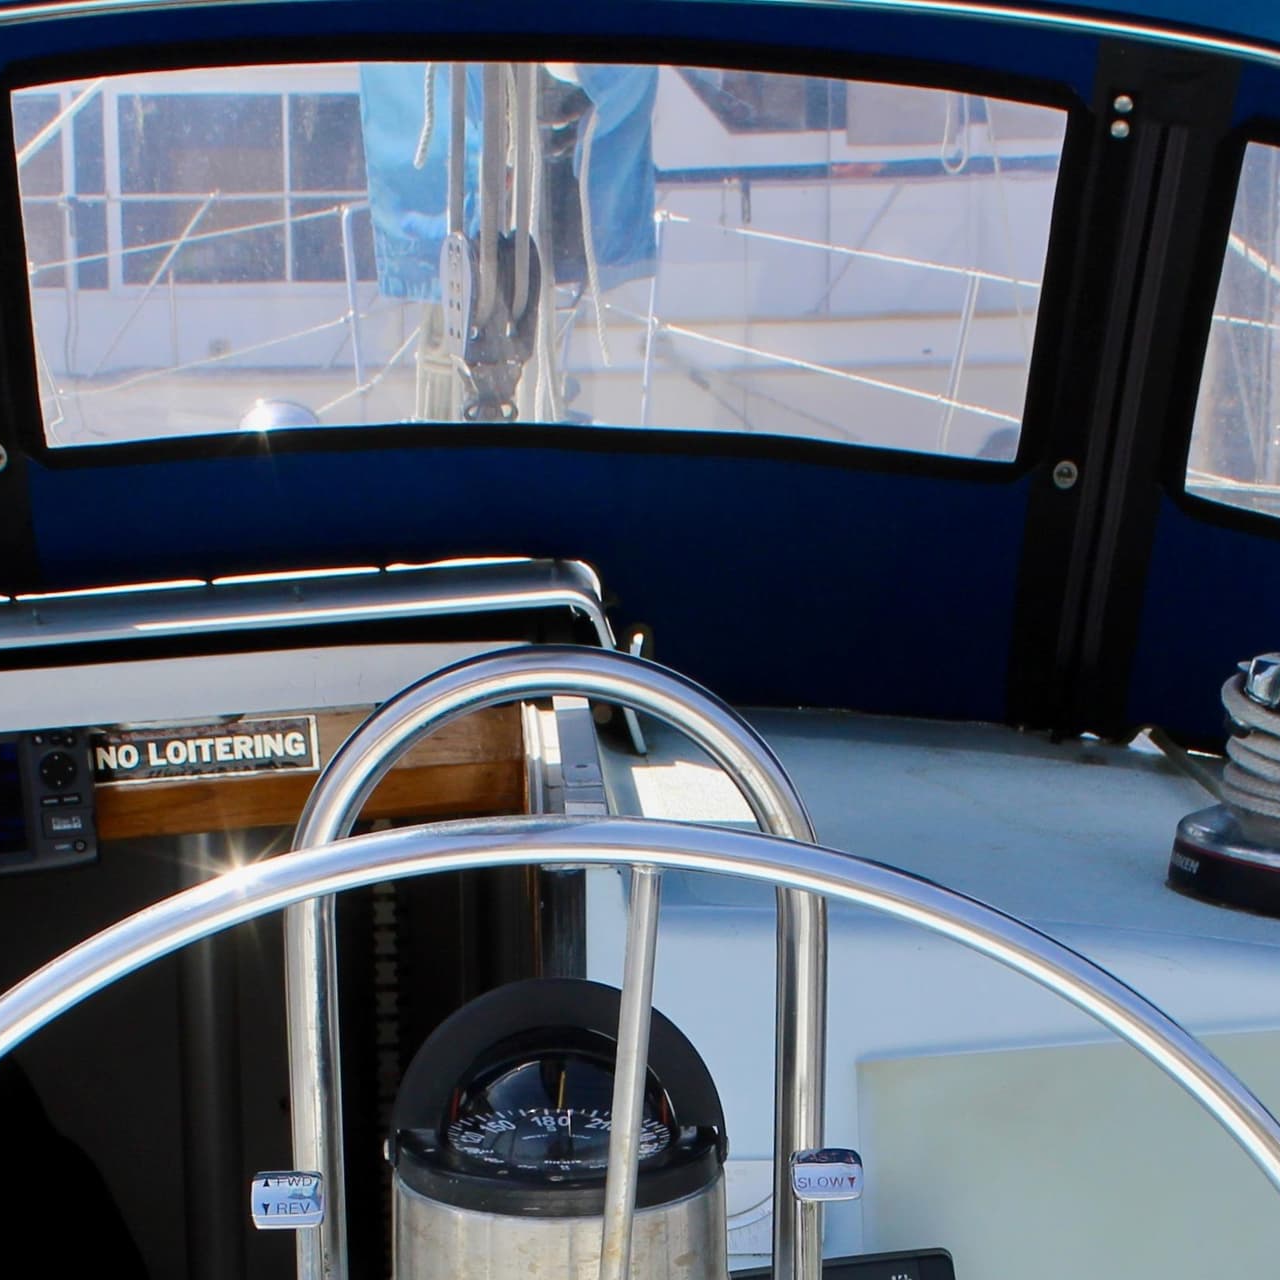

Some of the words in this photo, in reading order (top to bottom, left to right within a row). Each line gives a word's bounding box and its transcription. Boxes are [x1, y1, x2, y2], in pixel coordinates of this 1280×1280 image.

[96, 744, 140, 771] NO
[147, 731, 307, 767] LOITERING
[479, 1120, 517, 1134] 150
[530, 1115, 569, 1127] 180
[277, 1176, 313, 1187] FWD
[797, 1176, 844, 1189] SLOW
[276, 1202, 310, 1215] REV
